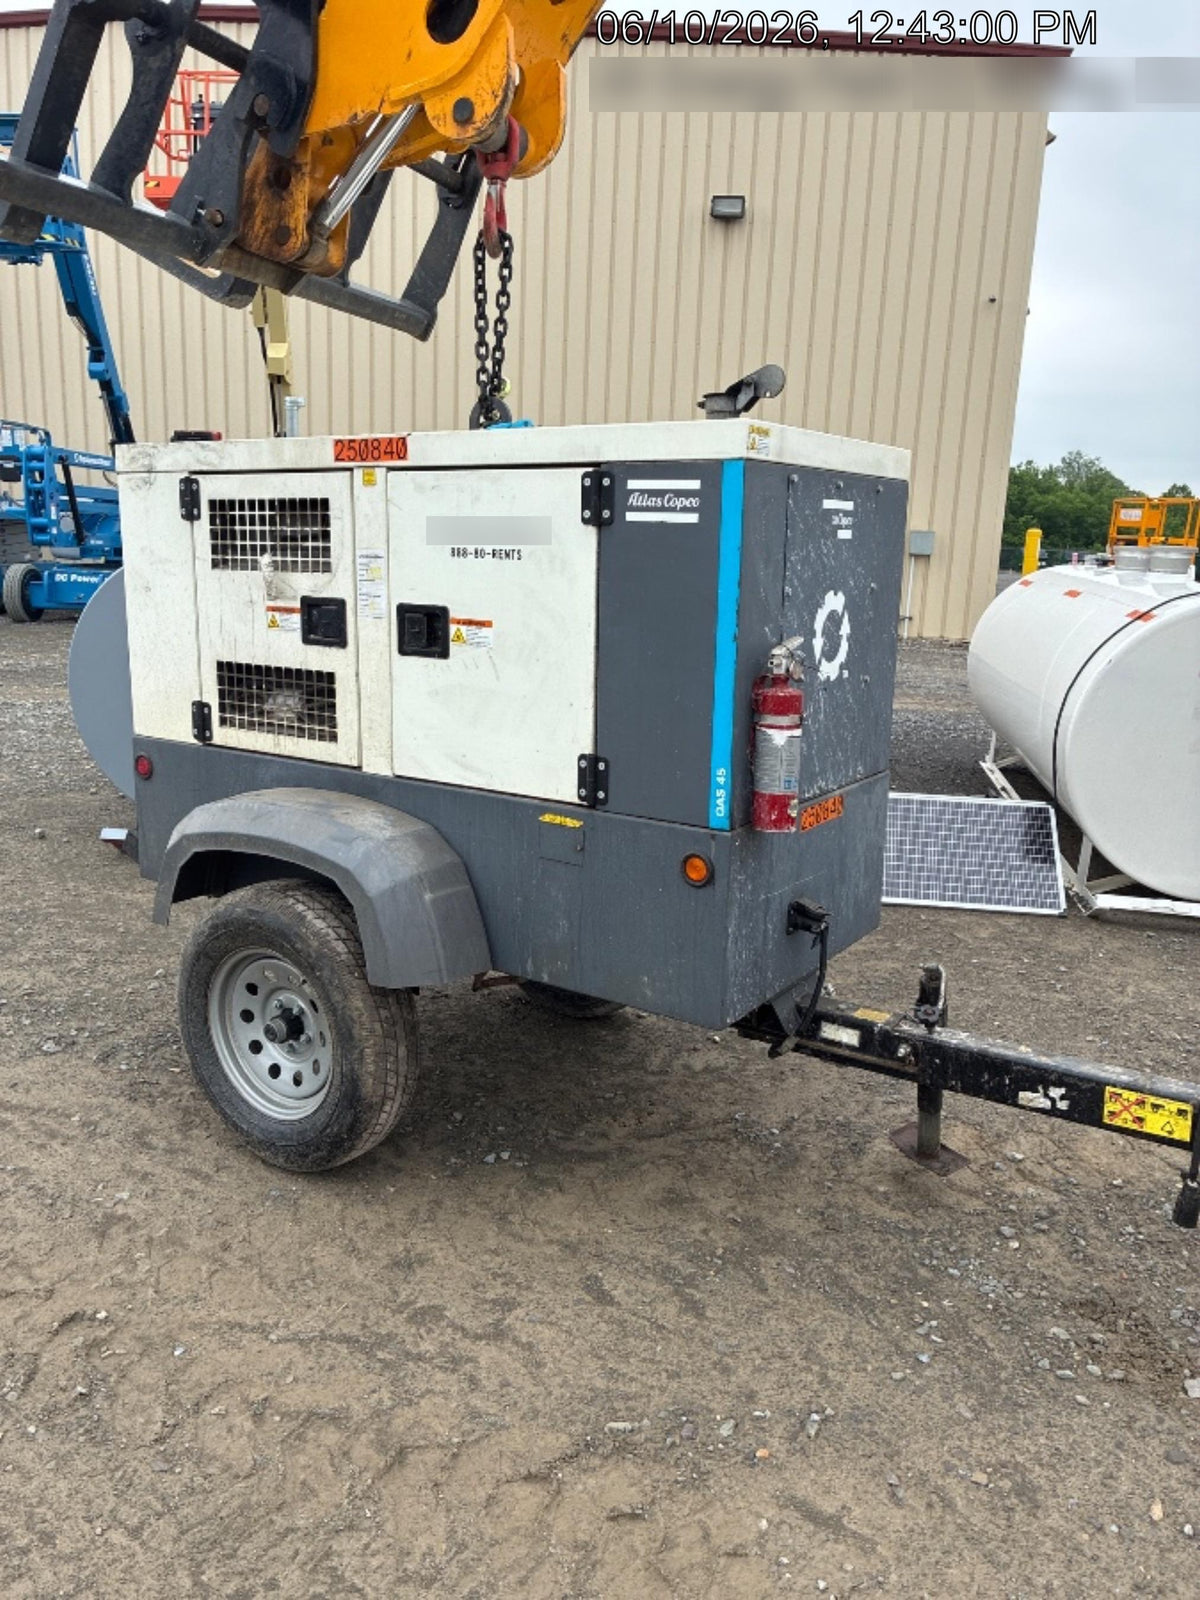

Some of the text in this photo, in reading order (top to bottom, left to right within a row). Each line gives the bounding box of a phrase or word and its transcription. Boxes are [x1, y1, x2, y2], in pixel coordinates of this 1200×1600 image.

[334, 437, 408, 461] 250840
[627, 492, 701, 511] Atlas Copco
[716, 767, 727, 785] 45
